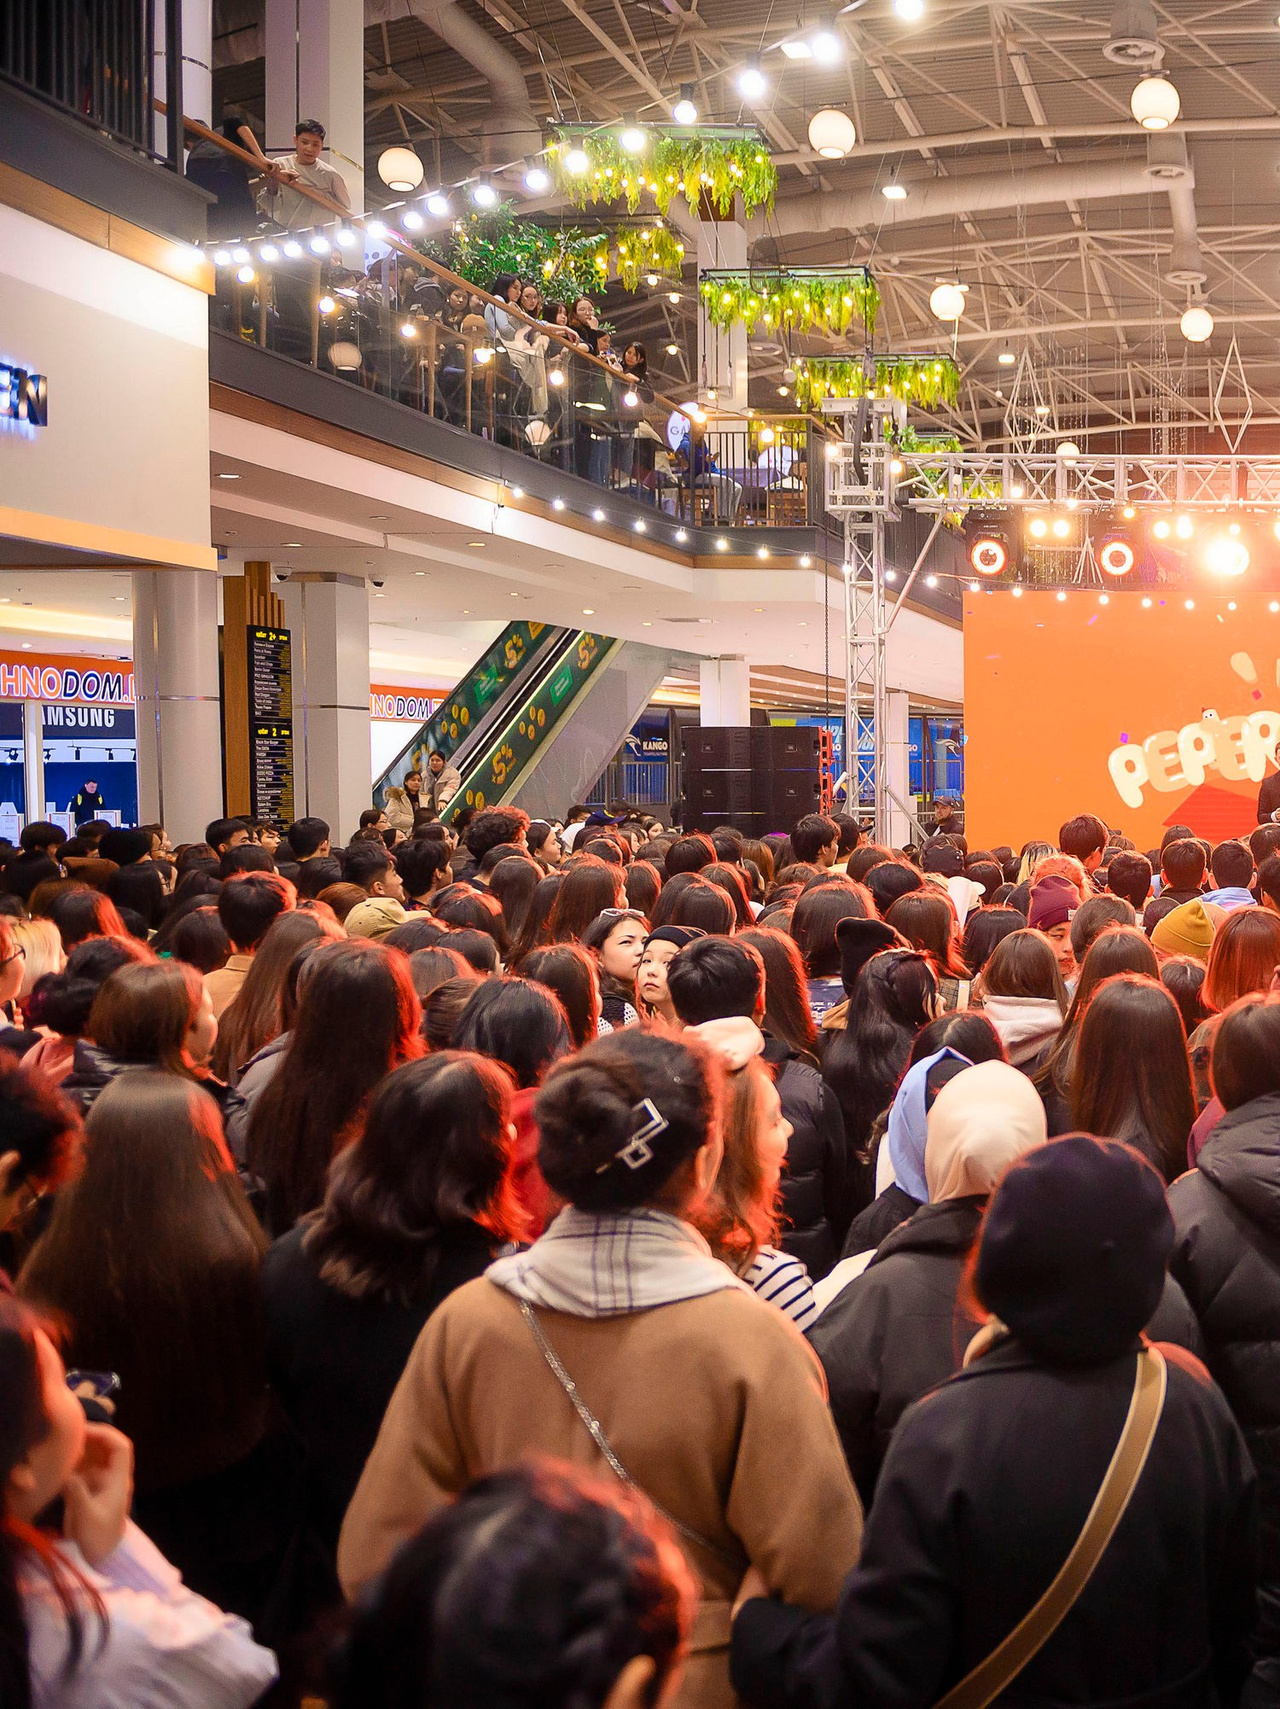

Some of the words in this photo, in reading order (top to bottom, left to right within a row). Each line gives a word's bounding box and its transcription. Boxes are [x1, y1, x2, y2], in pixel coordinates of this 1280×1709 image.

[670, 425, 690, 436] GA
[0, 663, 135, 704] HNODOM.
[370, 693, 446, 721] NODOM.
[21, 705, 115, 728] AMSUNG
[272, 727, 277, 737] 2
[642, 741, 668, 751] KANGO
